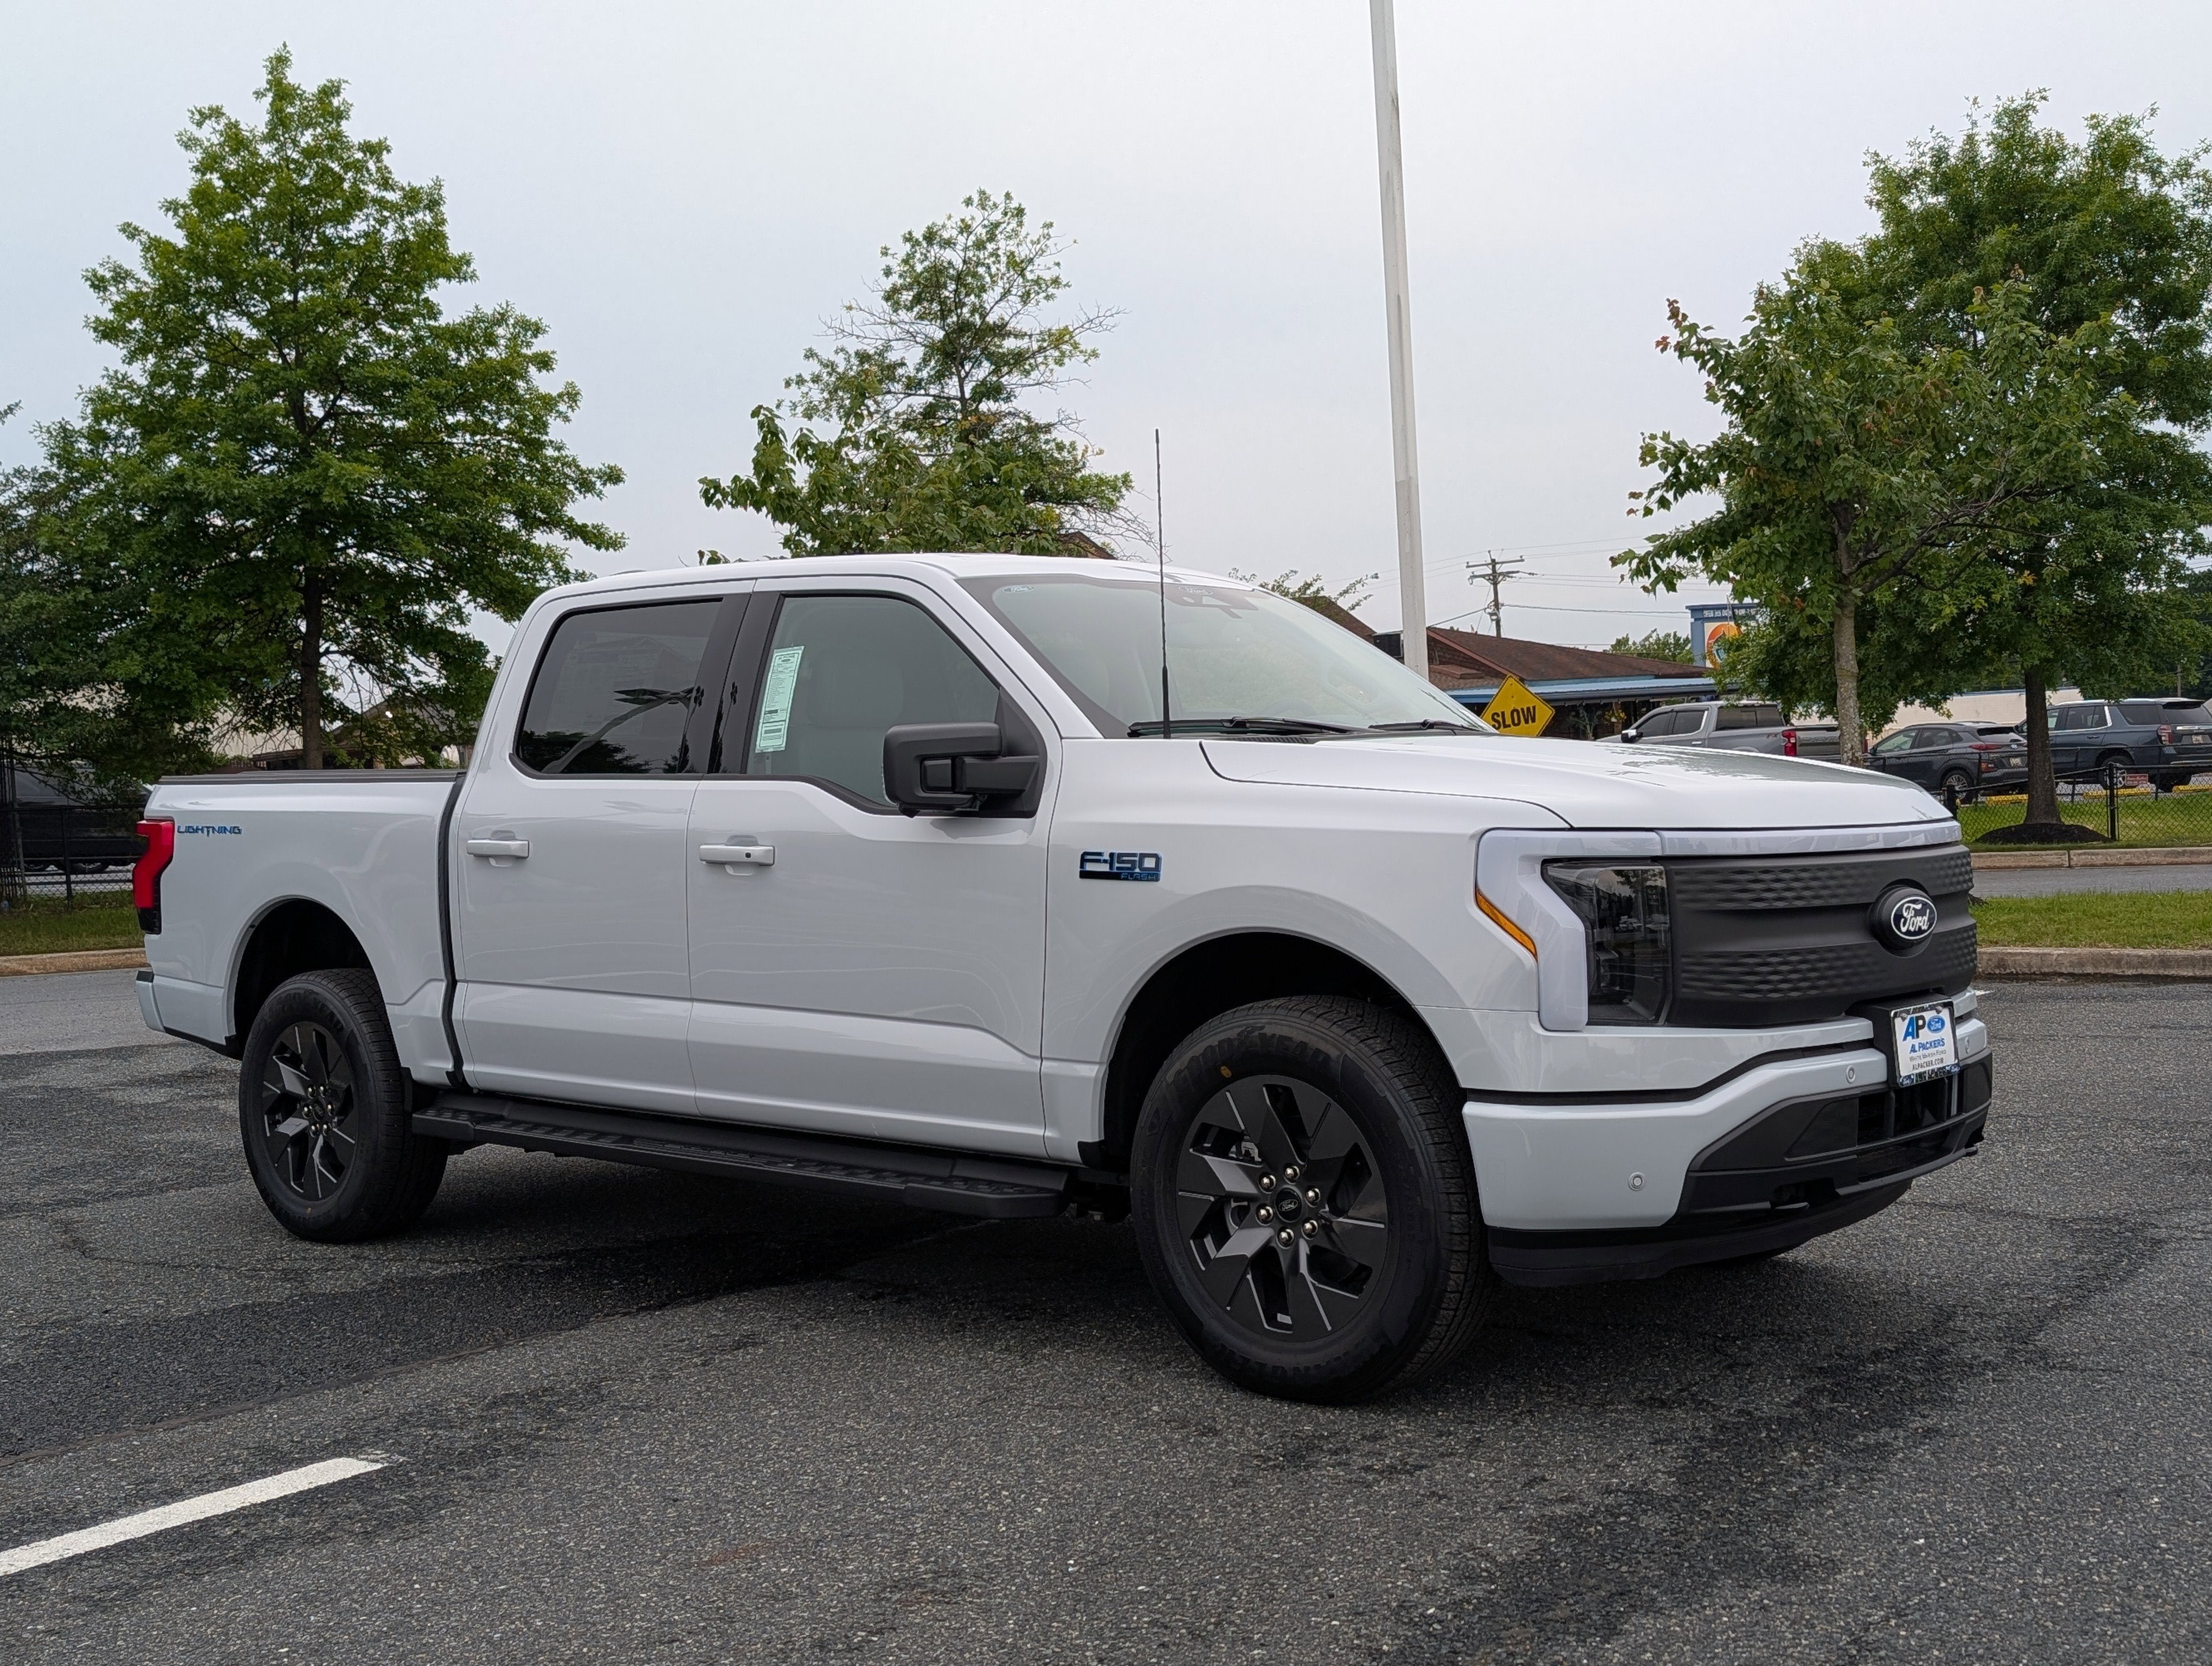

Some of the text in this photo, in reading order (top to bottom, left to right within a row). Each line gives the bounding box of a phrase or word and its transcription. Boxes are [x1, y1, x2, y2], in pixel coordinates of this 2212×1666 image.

[1491, 705, 1536, 729] SLOW
[177, 825, 242, 837] LIGHTNING
[1079, 851, 1162, 872] F-150
[1120, 873, 1156, 881] FLASH
[1900, 903, 1930, 933] Ford
[1902, 1015, 1926, 1041] AP
